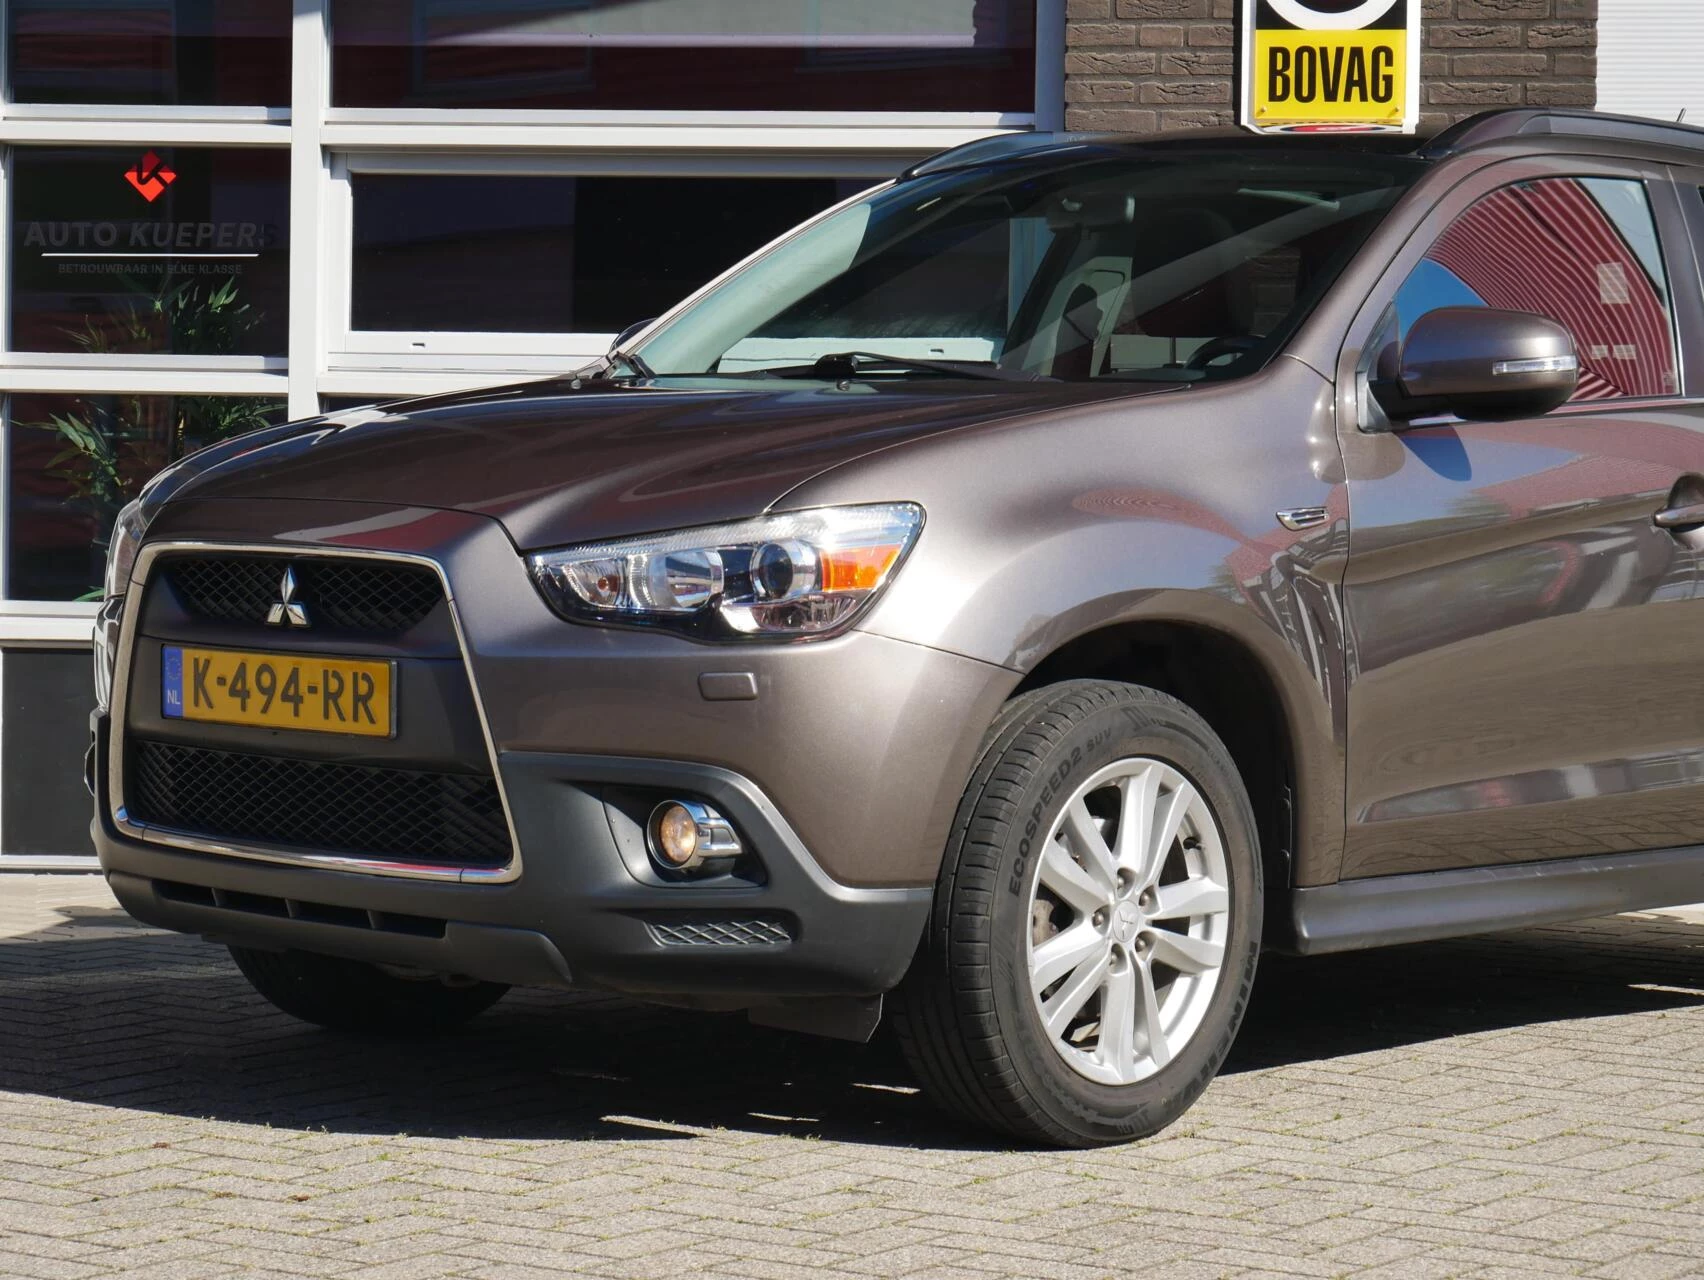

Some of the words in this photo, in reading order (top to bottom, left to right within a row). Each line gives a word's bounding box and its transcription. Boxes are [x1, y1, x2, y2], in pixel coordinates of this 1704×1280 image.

[1268, 45, 1394, 103] BOVAG
[23, 221, 118, 248] AUTO
[129, 222, 279, 248] KUEPERS
[58, 263, 147, 274] BETROUWBAAR
[151, 264, 163, 274] IN
[167, 263, 195, 274] ELKE
[199, 264, 242, 274] KLASSE
[167, 689, 181, 705] NL
[193, 656, 377, 726] K-494-RR
[1087, 728, 1112, 752] SUV
